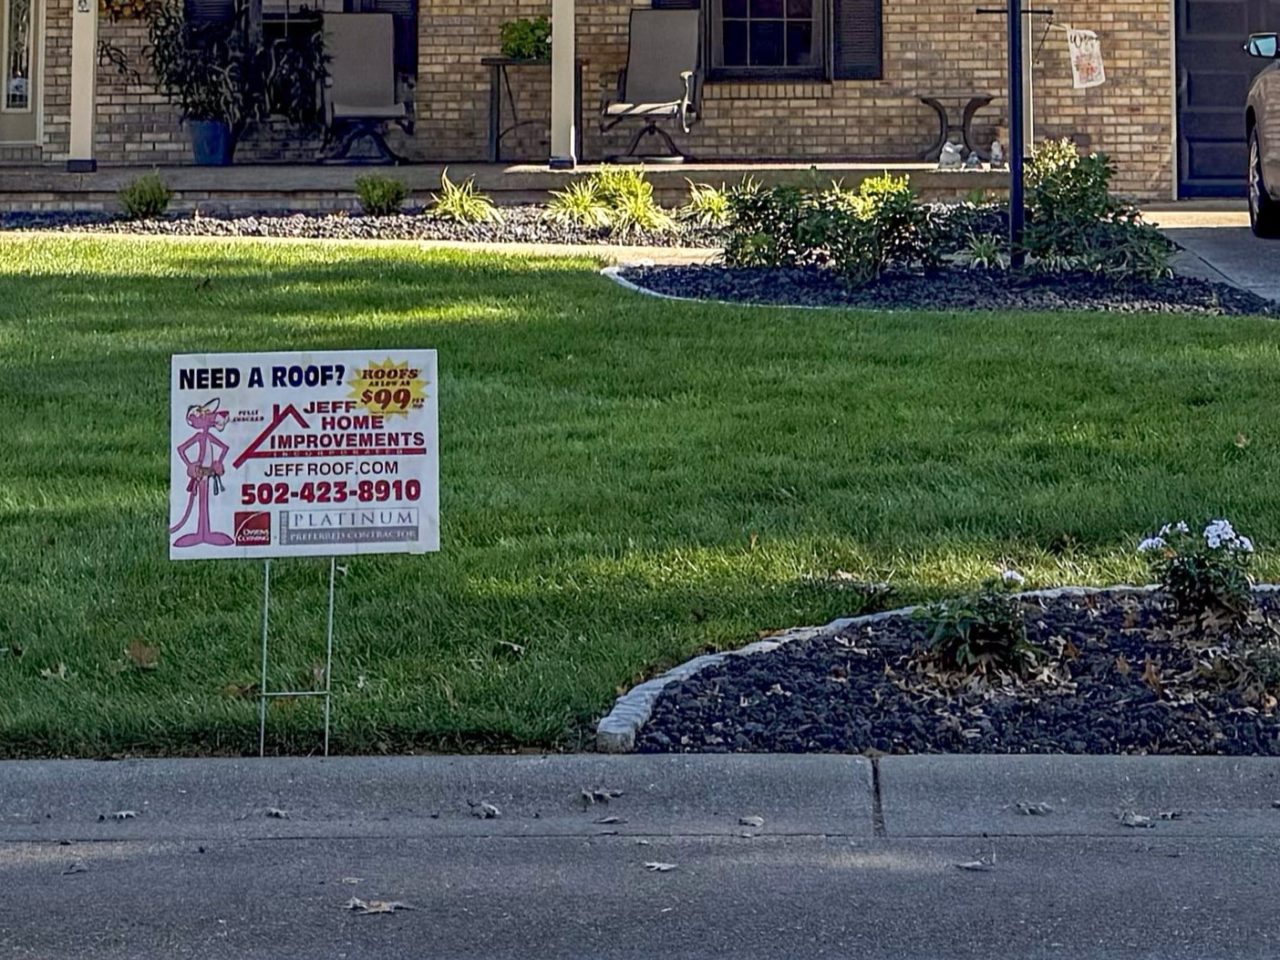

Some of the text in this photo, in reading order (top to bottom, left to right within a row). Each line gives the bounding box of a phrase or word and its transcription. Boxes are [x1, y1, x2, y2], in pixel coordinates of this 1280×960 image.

[179, 364, 346, 390] NEED A ROOF?
[362, 368, 419, 380] ROOFS
[361, 388, 411, 410] $99
[321, 415, 384, 431] HOME
[270, 432, 425, 450] IMPROVEMENTS
[241, 479, 421, 505] 502-423-8910
[294, 511, 413, 527] PLATINUM
